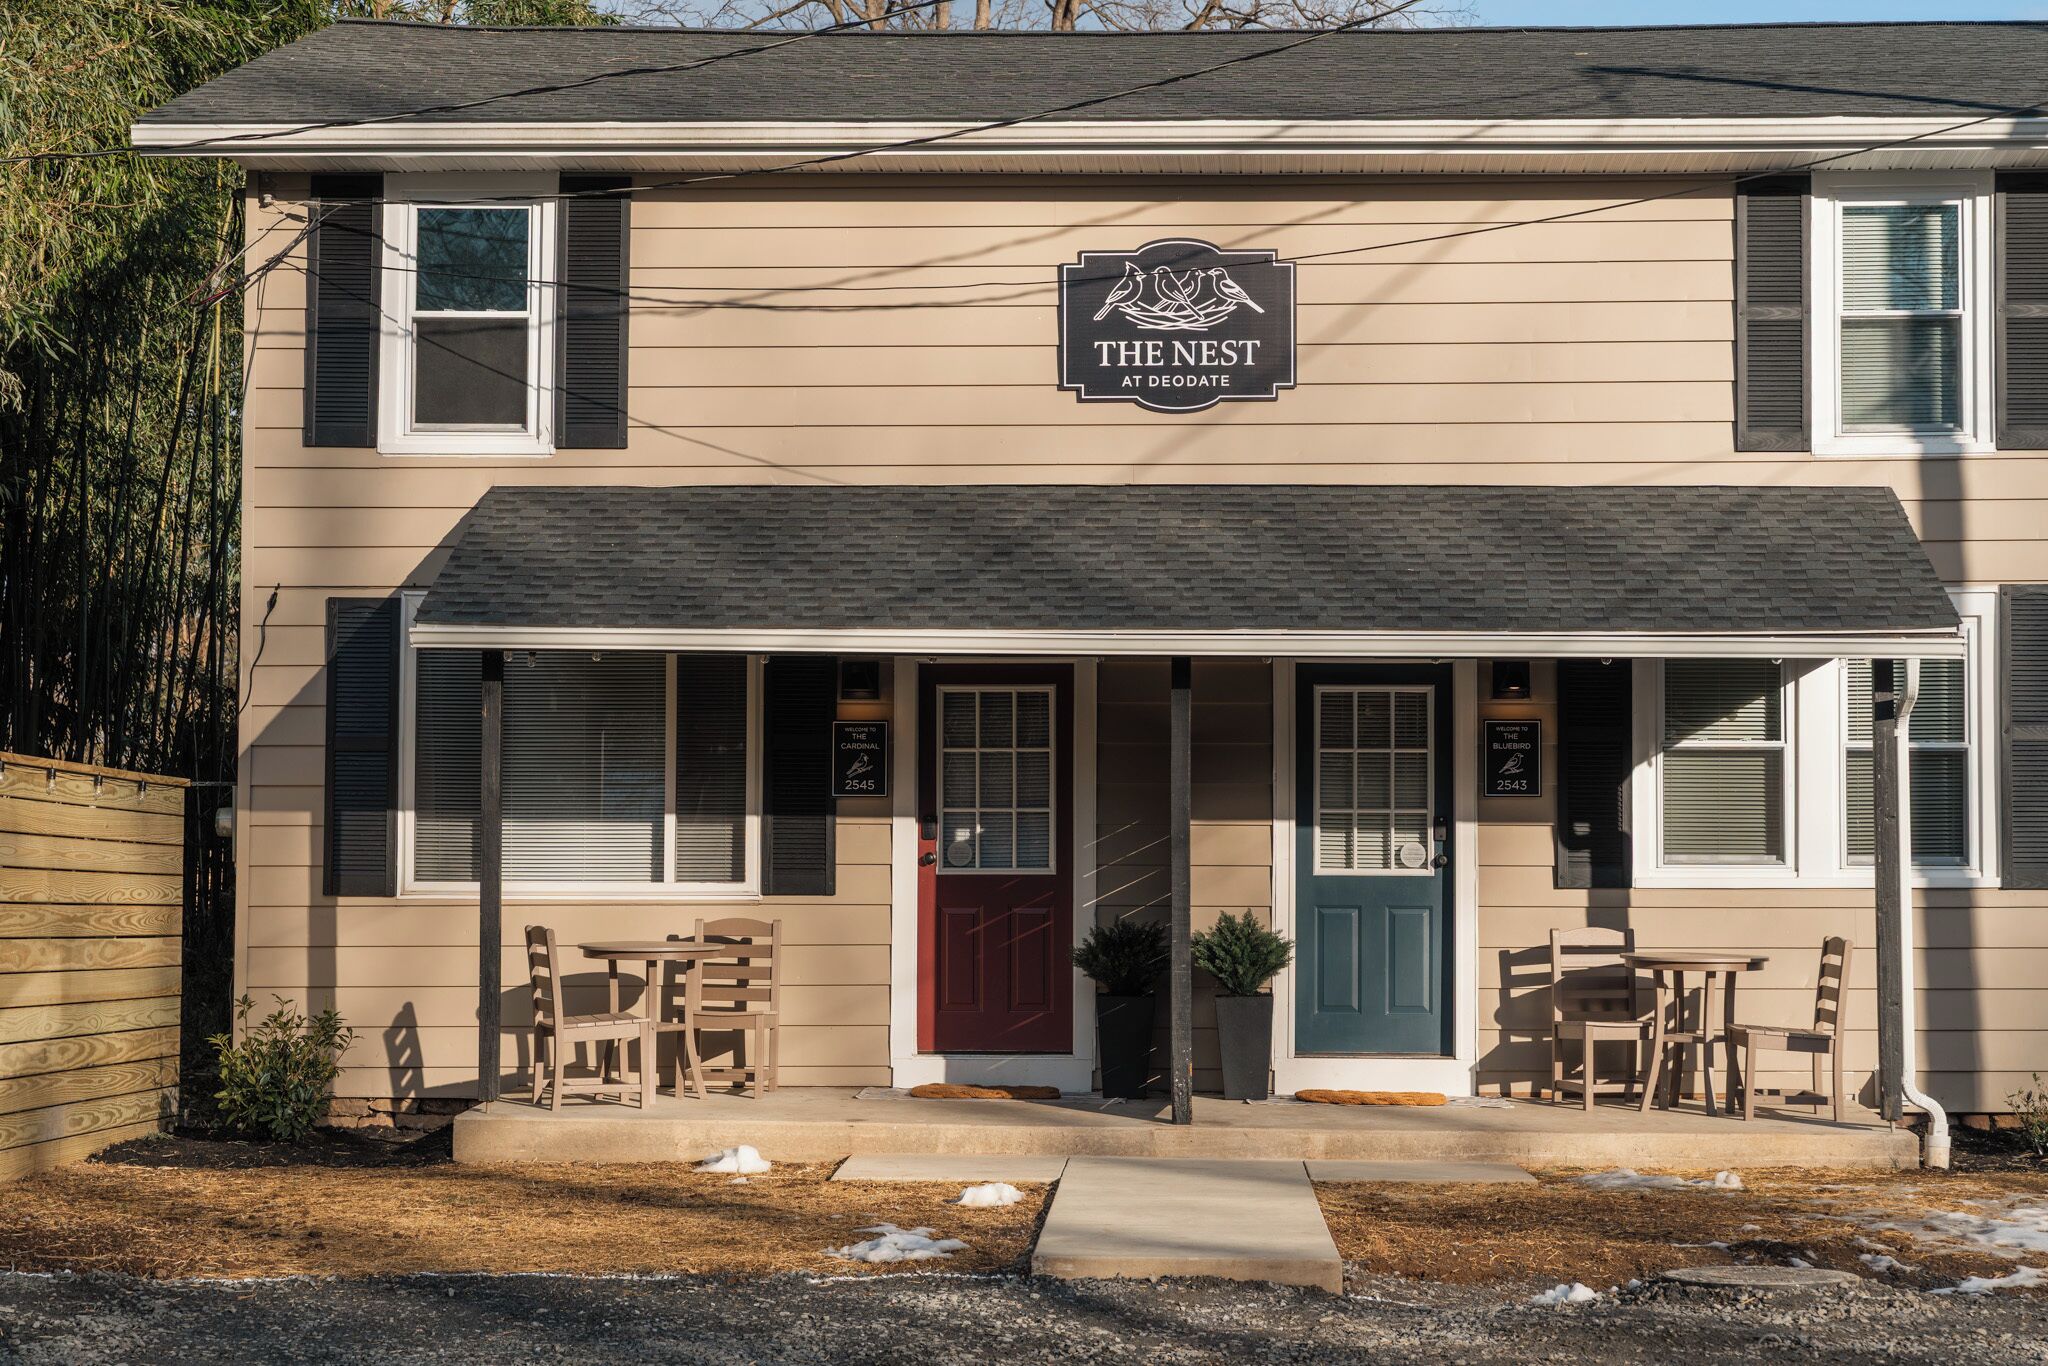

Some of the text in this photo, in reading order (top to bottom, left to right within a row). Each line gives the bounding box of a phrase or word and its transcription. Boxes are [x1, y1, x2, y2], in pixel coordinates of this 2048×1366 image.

[1094, 339, 1261, 367] THE NEST
[1121, 374, 1230, 388] AT DEODATE
[840, 742, 880, 750] CARDINAL
[1492, 742, 1531, 750] BLUEBIRD
[845, 779, 875, 790] 2545
[1496, 779, 1527, 790] 2543
